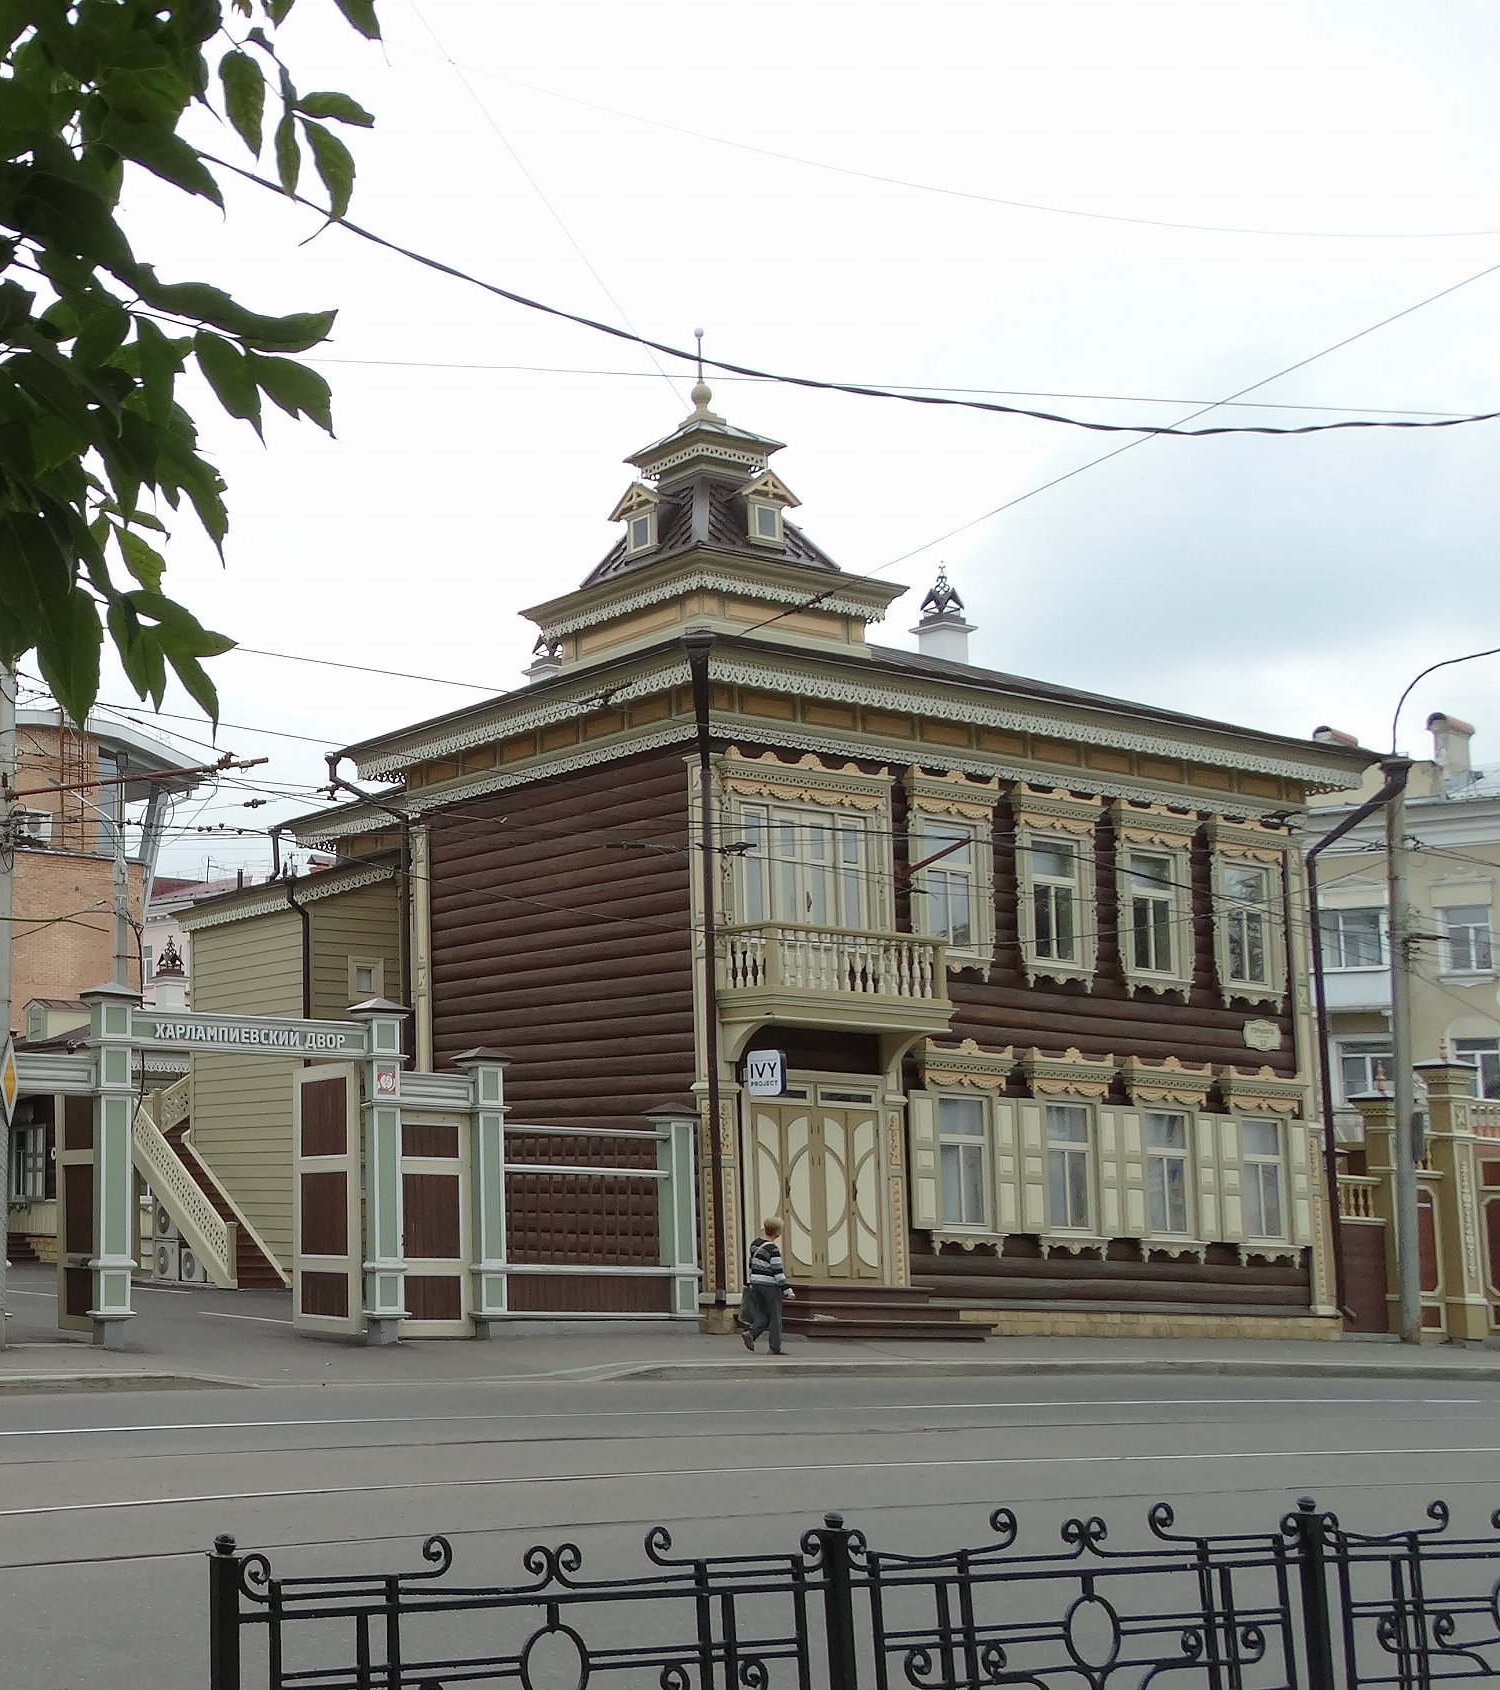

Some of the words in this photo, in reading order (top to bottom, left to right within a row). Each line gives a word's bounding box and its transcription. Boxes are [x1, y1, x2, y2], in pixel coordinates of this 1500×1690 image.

[154, 1022, 300, 1046] ХАРЛАМПИЕВСКИЙ
[304, 1032, 346, 1051] ДВОР
[750, 1062, 777, 1079] IVY
